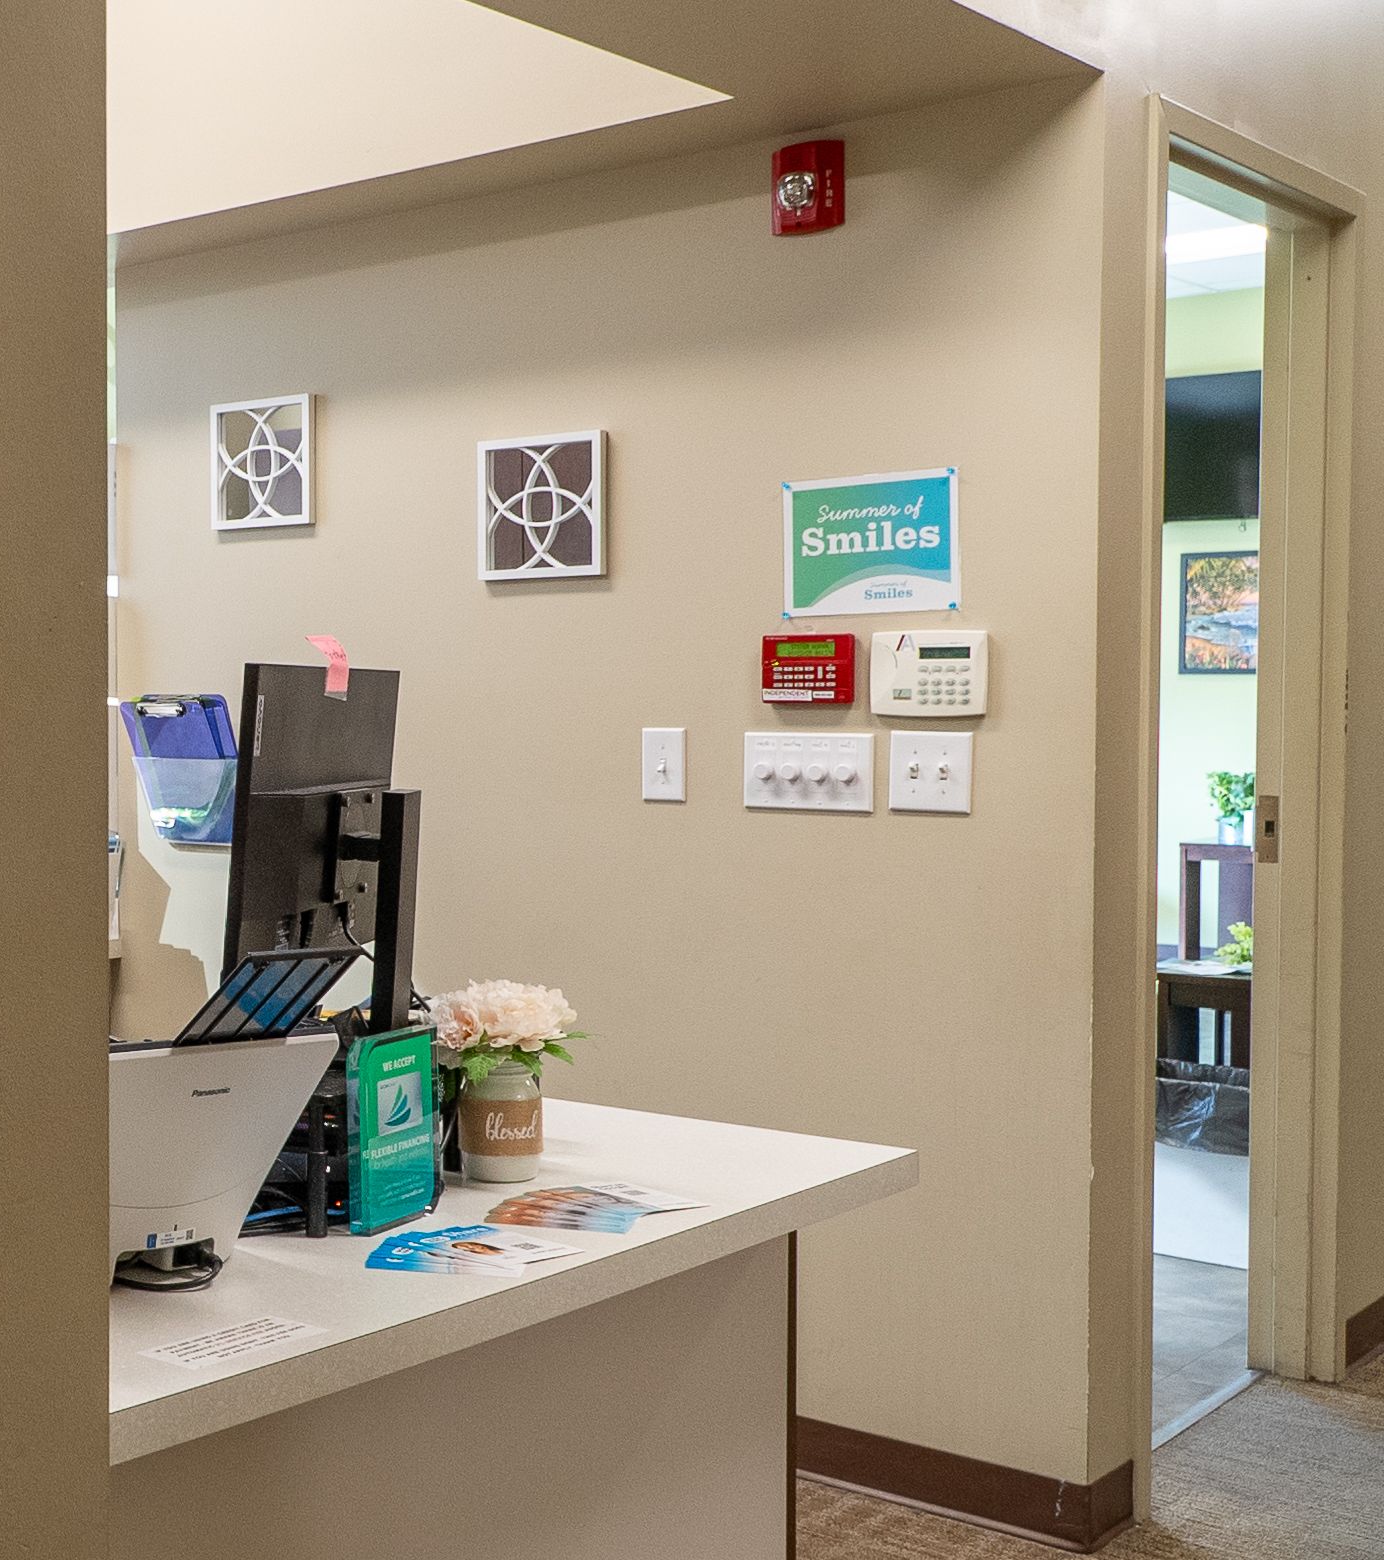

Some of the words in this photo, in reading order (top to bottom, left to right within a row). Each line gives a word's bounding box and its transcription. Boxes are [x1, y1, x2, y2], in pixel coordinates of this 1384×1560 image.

[825, 169, 833, 207] FIRE
[817, 503, 901, 523] Summer
[904, 495, 924, 519] of
[801, 520, 941, 556] Smiles
[864, 588, 913, 600] Smiles
[383, 1061, 392, 1072] WE
[393, 1055, 416, 1069] ACCEPT
[191, 1086, 231, 1097] Panasonic
[485, 1110, 539, 1141] blessed
